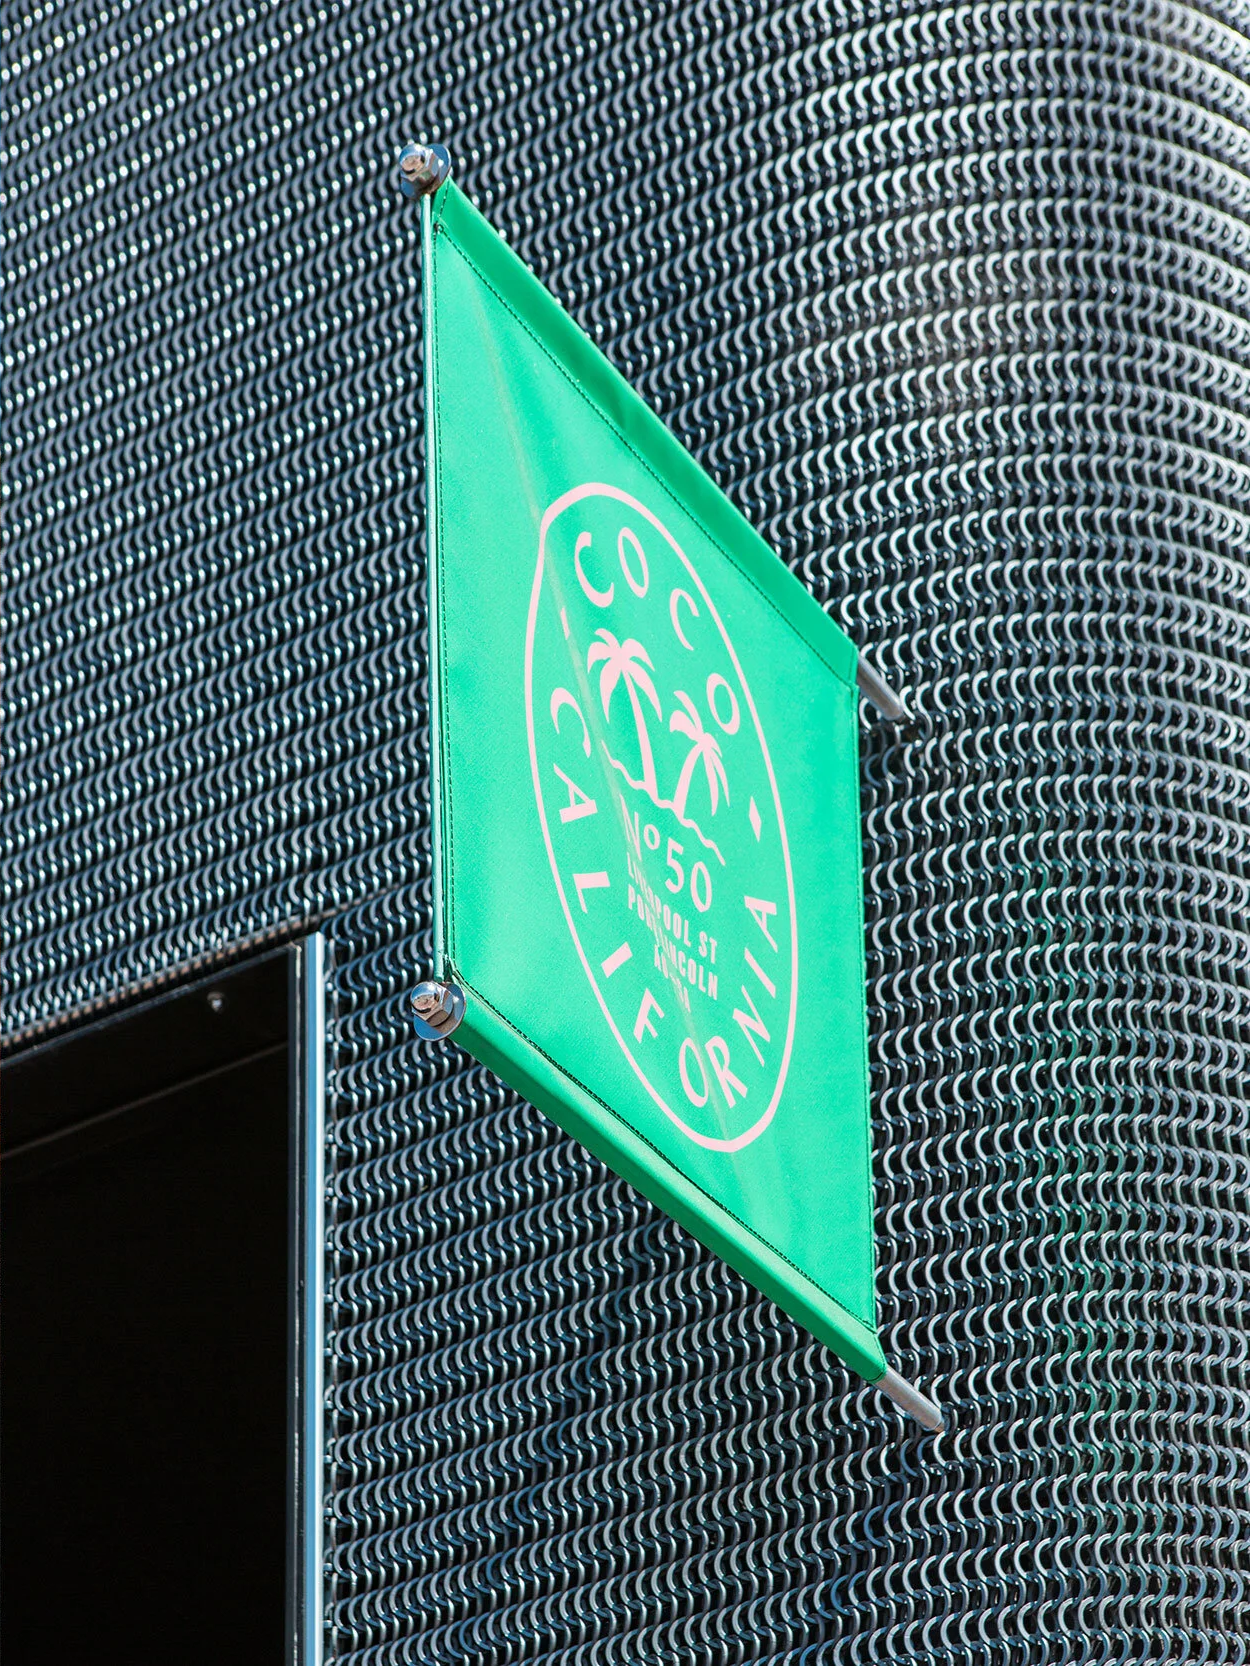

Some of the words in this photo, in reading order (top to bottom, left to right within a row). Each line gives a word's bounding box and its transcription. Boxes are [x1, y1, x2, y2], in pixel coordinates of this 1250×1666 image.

[574, 526, 741, 736] COCO
[549, 686, 779, 1109] CALIFORNIA
[626, 851, 692, 948] LIVRPOOL
[698, 930, 718, 965] ST
[664, 836, 713, 913] 50
